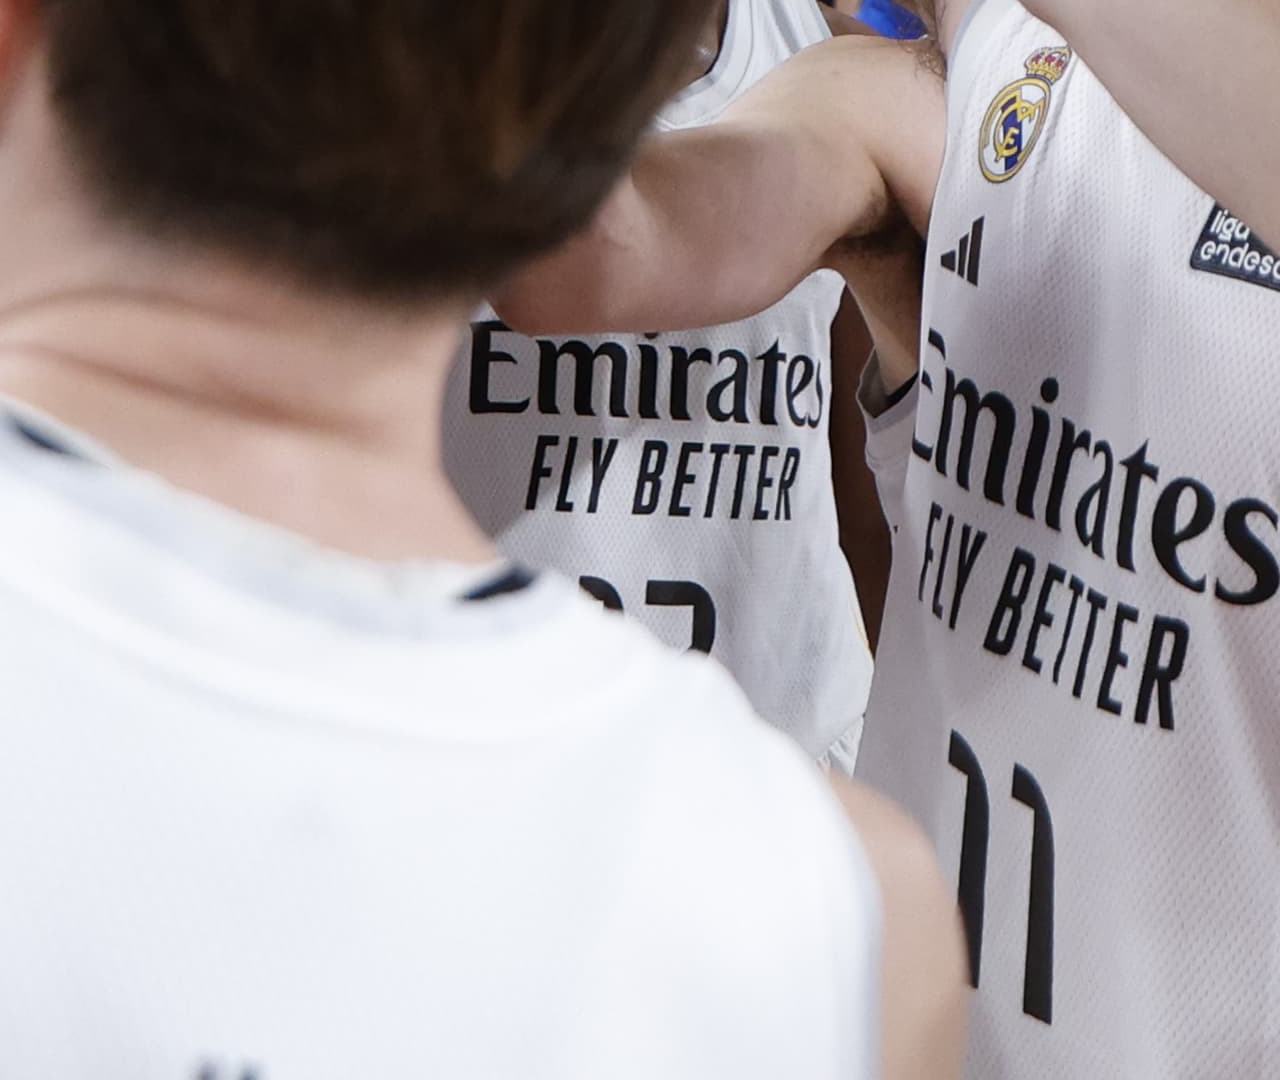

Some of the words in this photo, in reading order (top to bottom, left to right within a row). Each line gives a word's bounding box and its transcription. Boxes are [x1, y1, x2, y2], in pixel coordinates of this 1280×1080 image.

[524, 434, 619, 514] FLY
[632, 439, 801, 521] BETTER
[918, 501, 988, 631] FLY
[983, 546, 1190, 730] BETTER
[947, 728, 1056, 1026] 11
